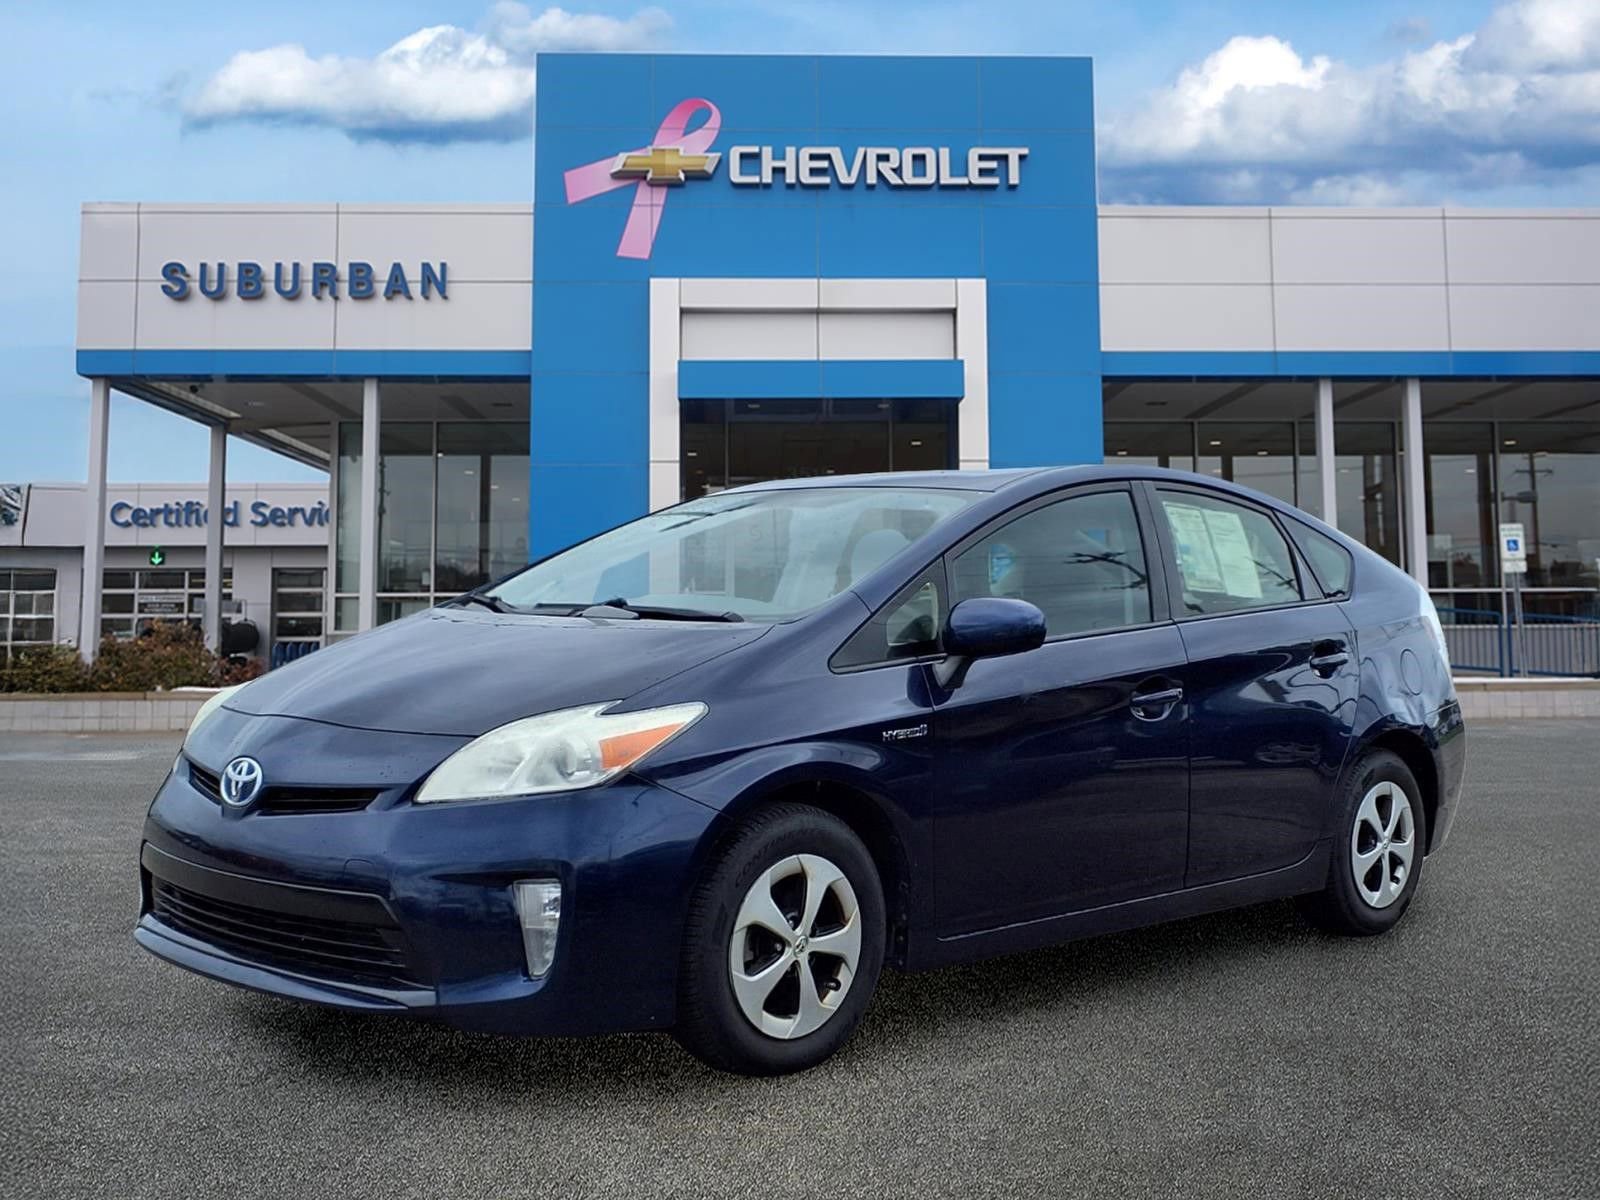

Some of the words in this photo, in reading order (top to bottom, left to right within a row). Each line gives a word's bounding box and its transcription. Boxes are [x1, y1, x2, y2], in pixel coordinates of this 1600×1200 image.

[729, 146, 1029, 186] CHEVROLET
[161, 262, 449, 300] SUBURBAN
[110, 501, 240, 528] Certifid
